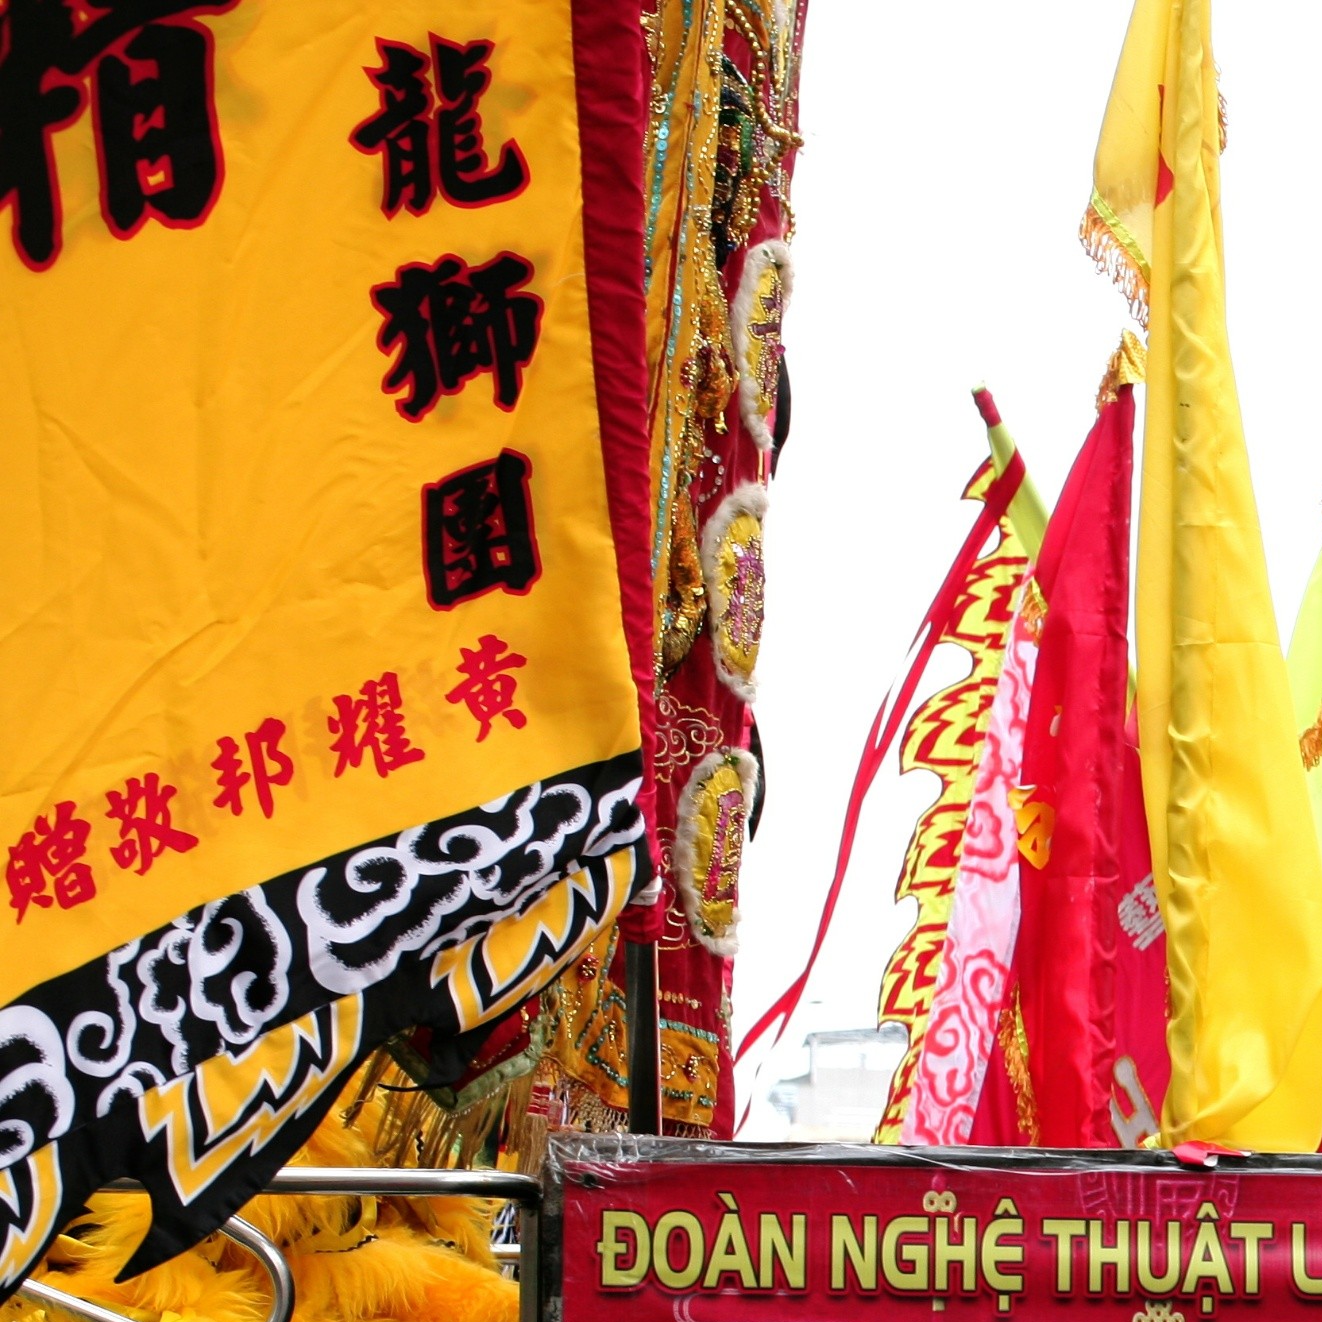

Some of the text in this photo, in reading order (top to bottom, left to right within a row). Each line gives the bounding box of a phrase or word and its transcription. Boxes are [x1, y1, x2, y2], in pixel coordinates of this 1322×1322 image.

[347, 31, 545, 612] 龍獅團
[596, 1193, 806, 1290] ĐOÀN
[830, 1199, 1024, 1312] NGHỆ
[1043, 1202, 1272, 1312] THUẬT
